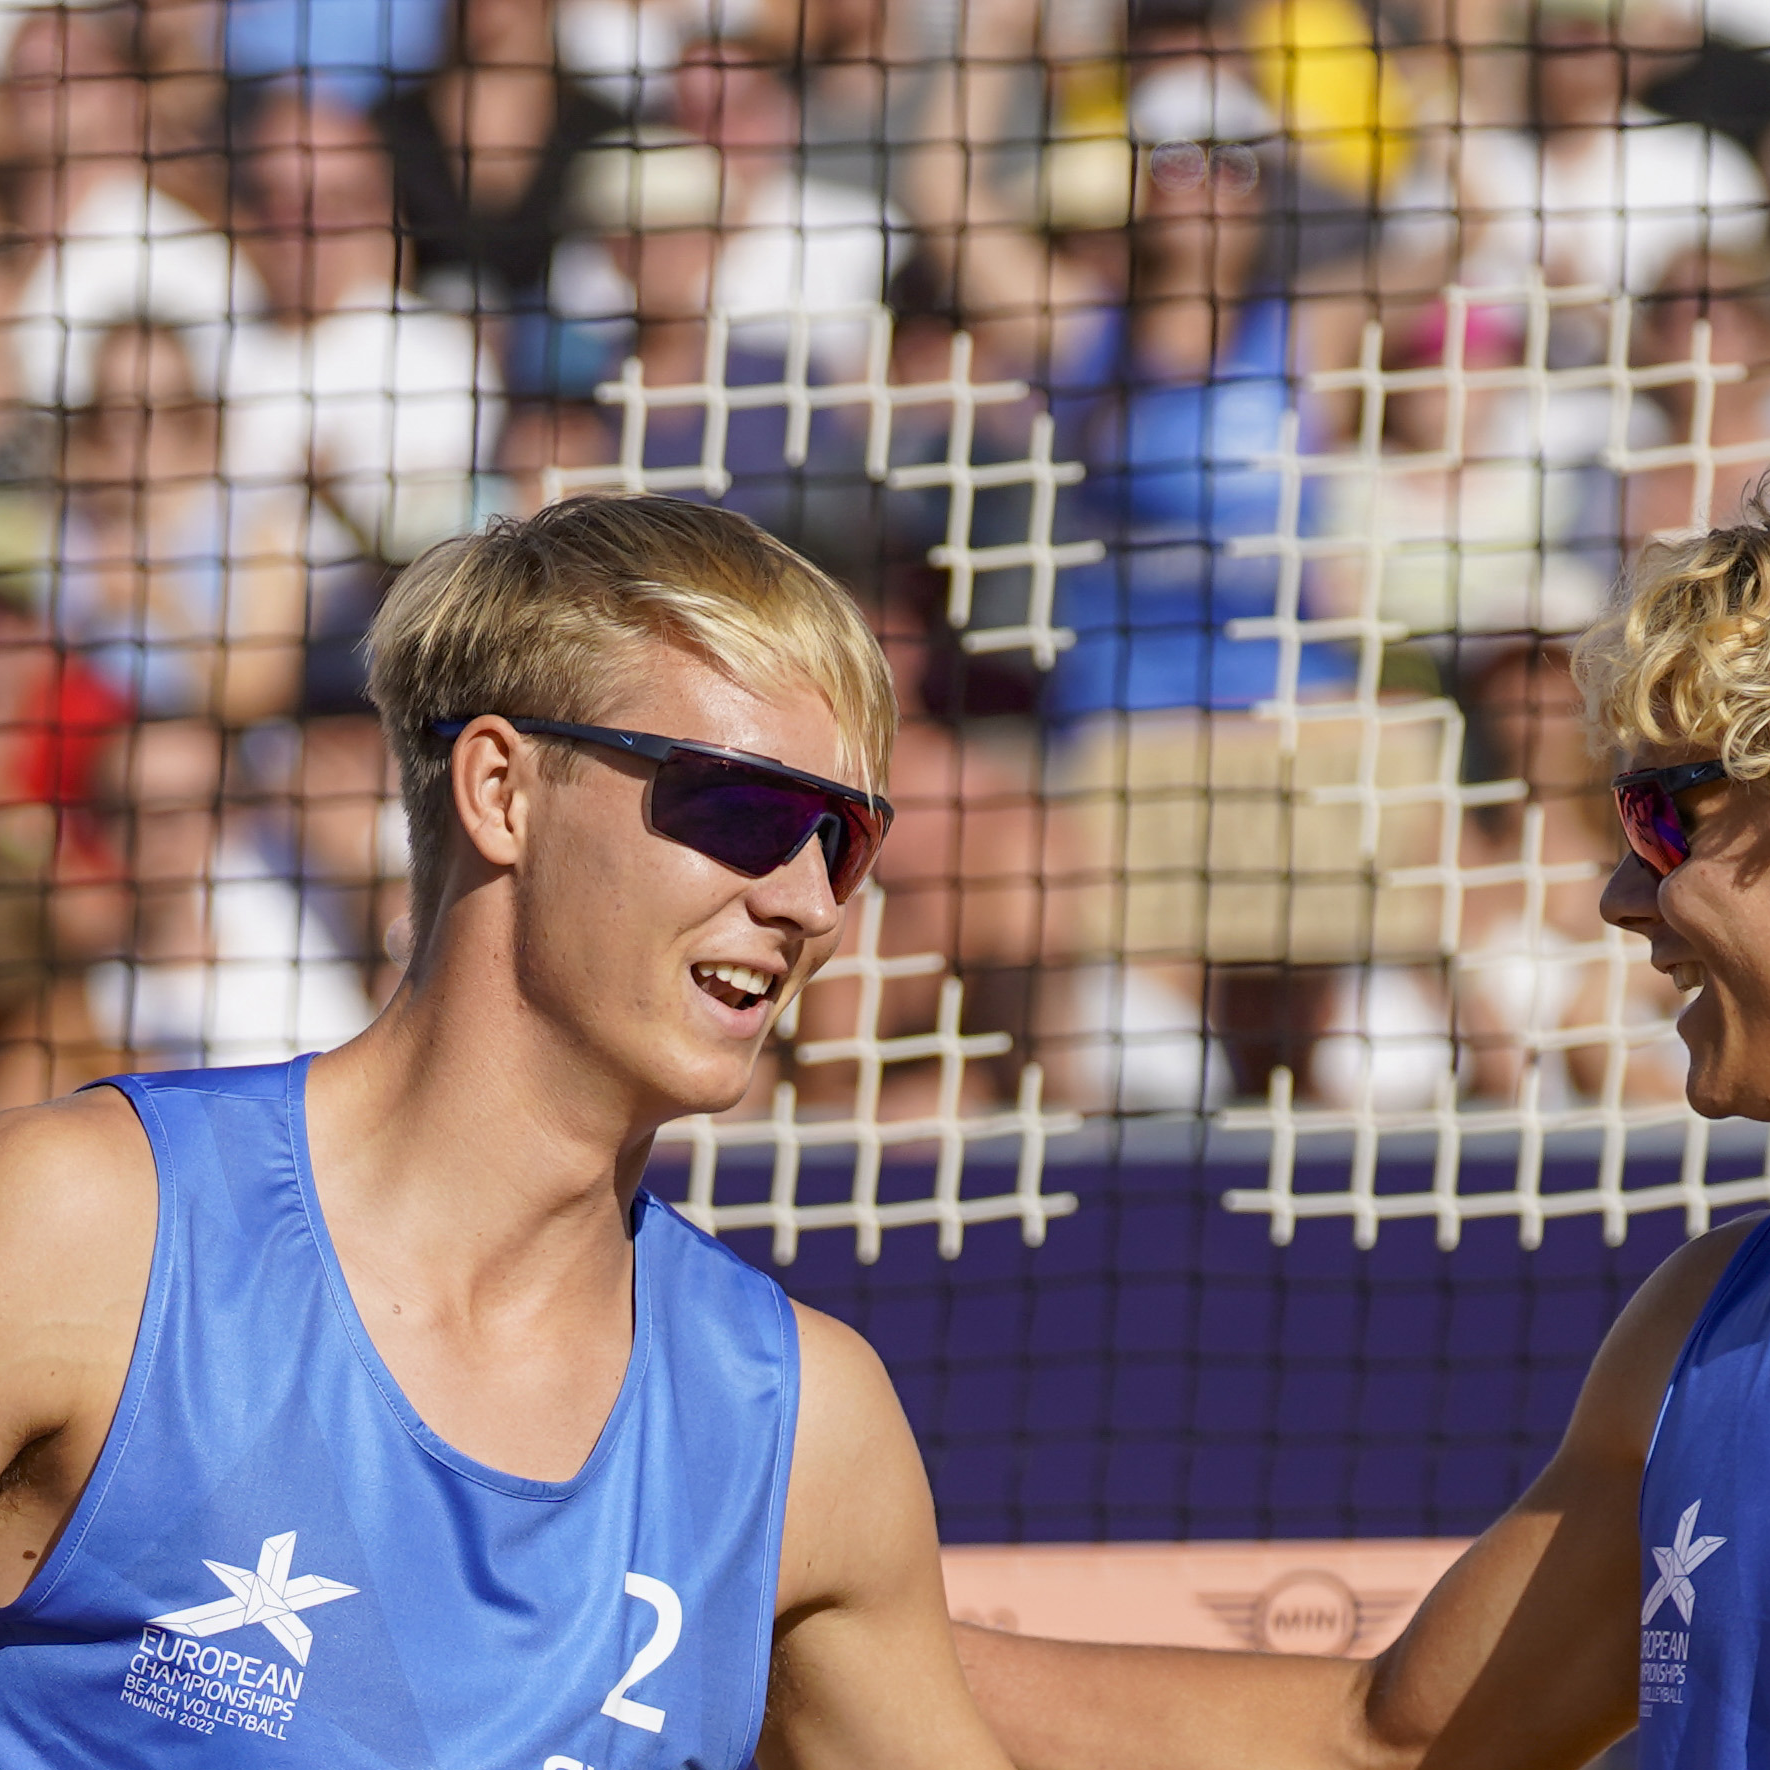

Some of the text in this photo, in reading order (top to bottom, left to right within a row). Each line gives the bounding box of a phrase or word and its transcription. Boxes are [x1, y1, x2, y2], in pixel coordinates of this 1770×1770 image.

[139, 1626, 304, 1700] EUROPEAN
[600, 1572, 682, 1733] 2
[1641, 1630, 1690, 1661] ROPEAN
[120, 1689, 216, 1735] MUNICH 2022
[124, 1673, 287, 1741] BEACH VOLLEYBALL
[130, 1654, 296, 1721] CHAMPIONSHIPS
